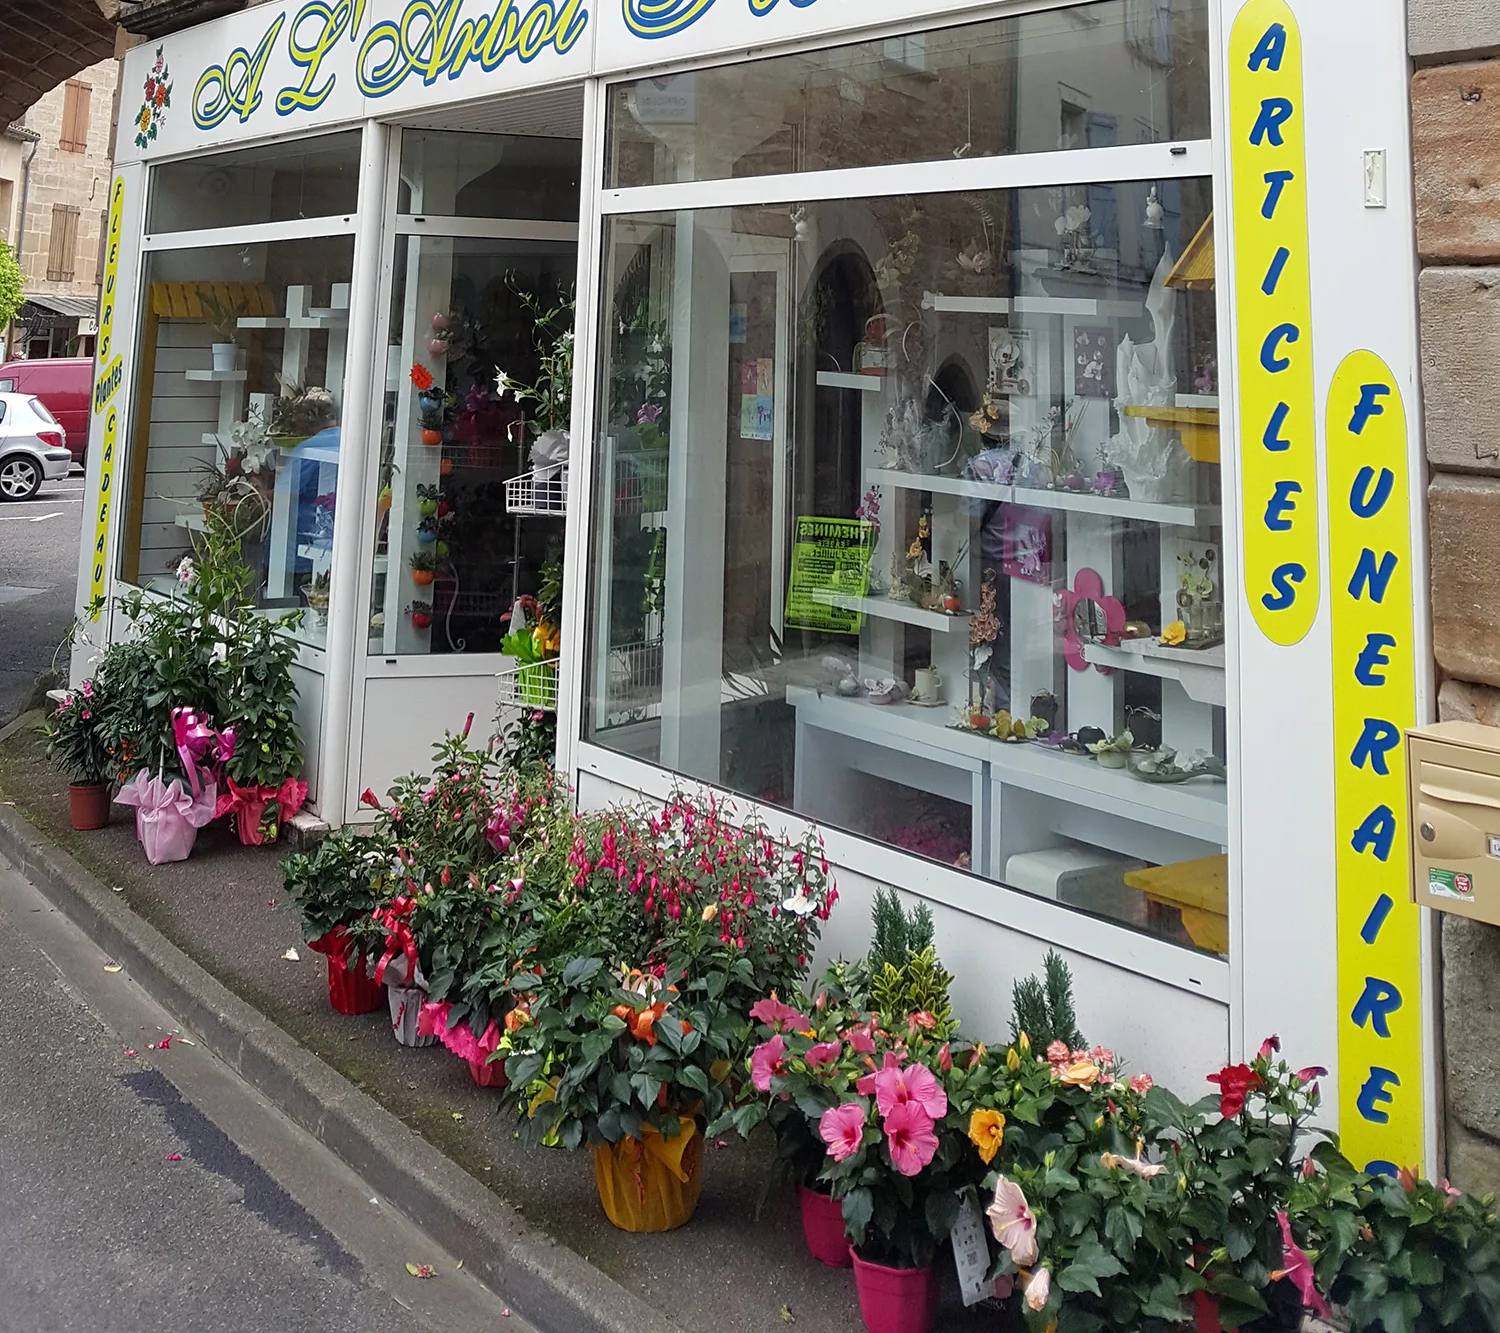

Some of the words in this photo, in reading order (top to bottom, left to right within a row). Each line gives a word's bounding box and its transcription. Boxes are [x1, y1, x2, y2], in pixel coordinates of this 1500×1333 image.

[191, 11, 287, 131] A
[100, 180, 123, 356] FLEURS
[1247, 23, 1306, 611] ARTICLES
[95, 360, 123, 414] Plantes
[1348, 384, 1402, 1179] FUNERAIRE
